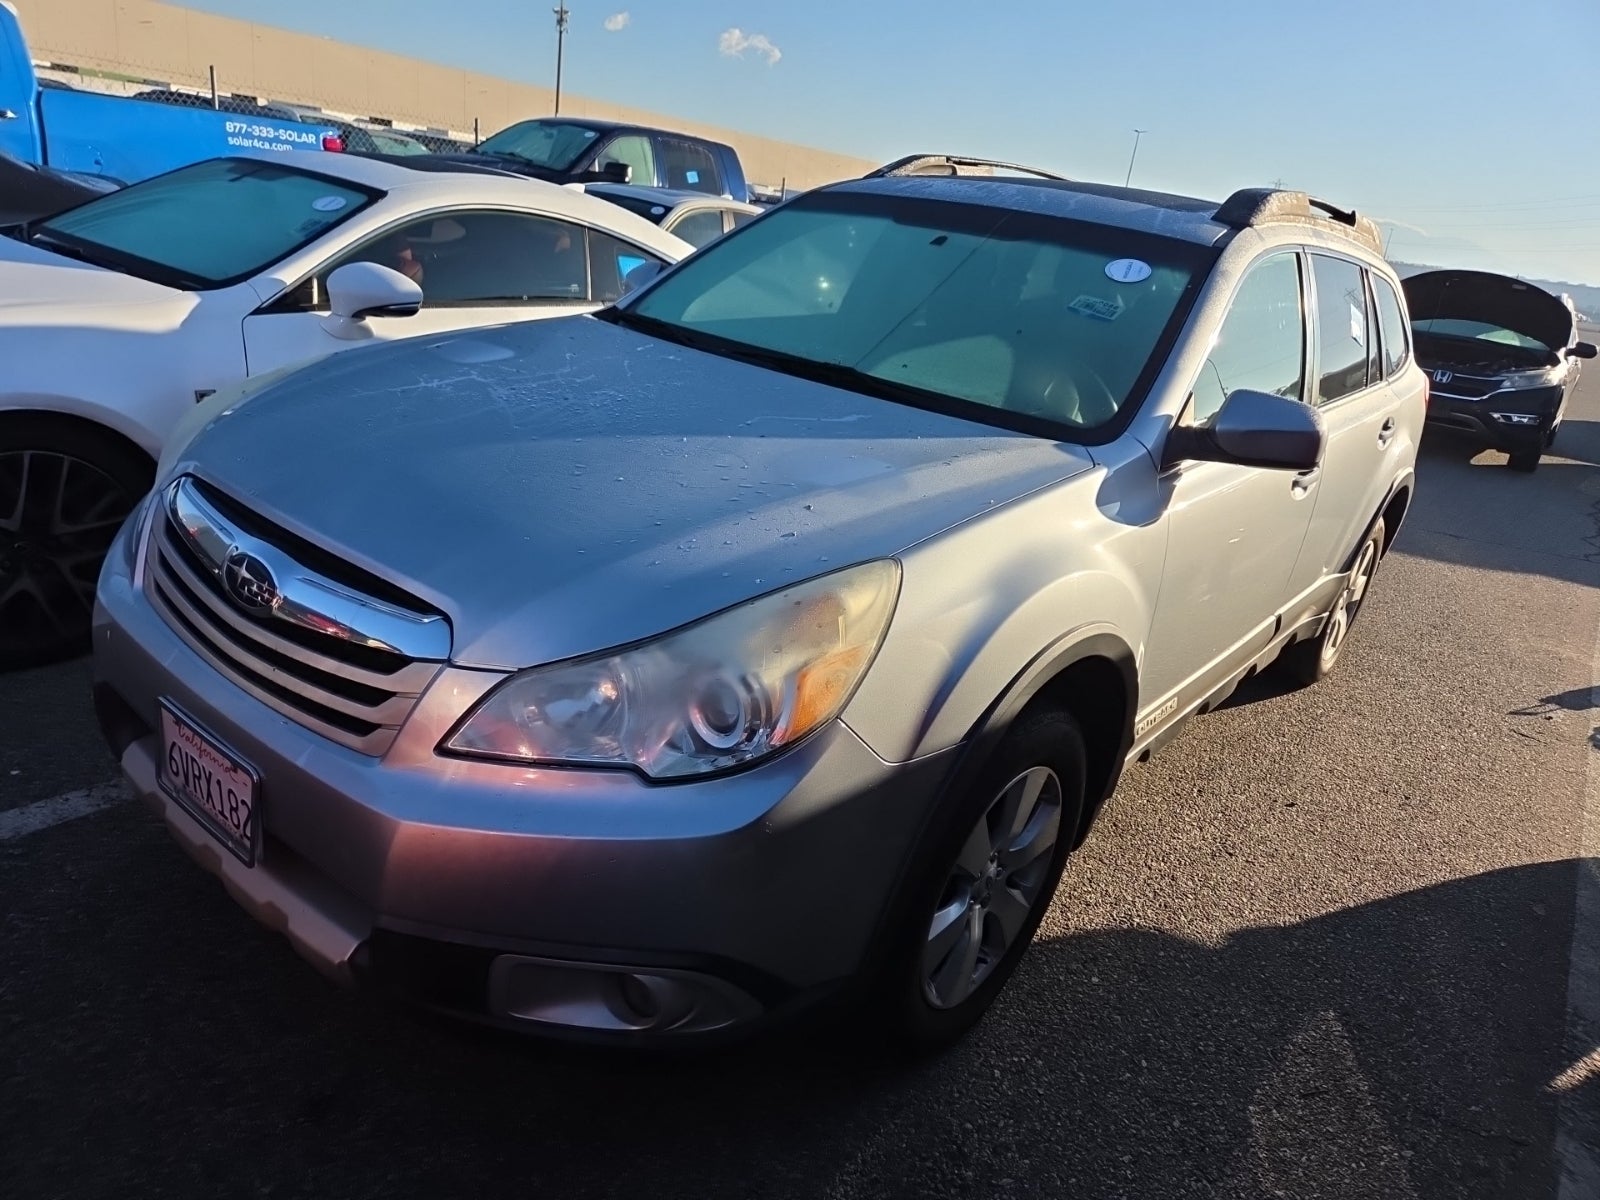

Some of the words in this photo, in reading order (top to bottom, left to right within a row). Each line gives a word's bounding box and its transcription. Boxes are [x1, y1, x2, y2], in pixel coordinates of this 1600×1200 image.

[226, 121, 316, 144] 877-333-SOLAR
[227, 136, 293, 152] solar4ca.com
[173, 719, 238, 784] California
[168, 740, 252, 841] 6VRX182
